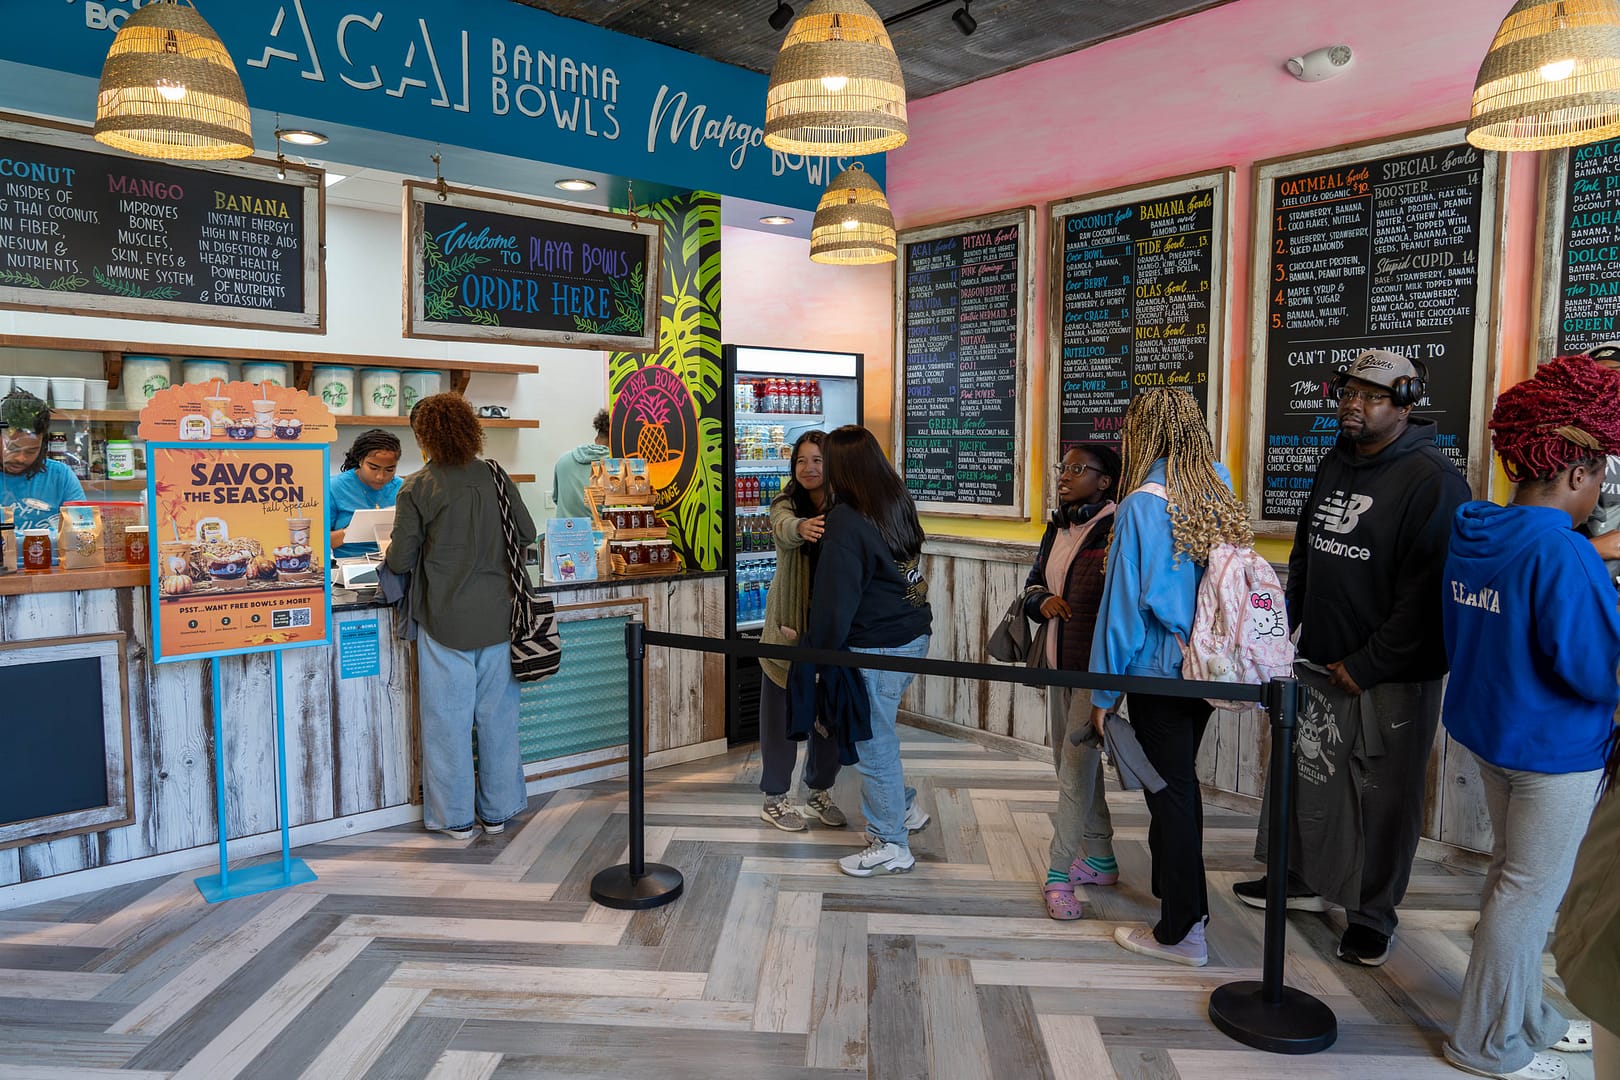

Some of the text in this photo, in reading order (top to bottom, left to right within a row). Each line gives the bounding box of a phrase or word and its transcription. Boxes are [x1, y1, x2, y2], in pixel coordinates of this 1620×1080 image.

[491, 38, 620, 103] BANANA
[491, 77, 620, 140] BOWLS
[647, 84, 766, 170] Mango
[1575, 144, 1609, 161] ACAI
[1383, 147, 1477, 180] SPECIAL bowls
[1575, 159, 1598, 169] PLAYA
[107, 174, 184, 200] MANGO
[1281, 167, 1369, 196] OATMEAL bowls
[1573, 178, 1600, 194] Pink
[6, 183, 73, 204] INSIDES OF
[1374, 180, 1428, 199] BOOSTER
[1439, 190, 1455, 199] FLAX
[214, 190, 290, 219] BANANA
[1282, 197, 1297, 207] STEEL
[1300, 195, 1311, 204] CUT
[1320, 189, 1351, 200] ORGANIC
[1574, 192, 1601, 203] PLAYA
[15, 201, 43, 217] THAI
[119, 200, 178, 220] IMPROVES
[1139, 193, 1212, 221] BANANA bowls
[1376, 197, 1473, 218] VANILLA PEANUT
[1573, 200, 1611, 212] COCONUT
[208, 212, 294, 234] INSTANT ENERGY!
[1068, 213, 1113, 233] COCONUT
[1150, 218, 1174, 229] BANANA
[1332, 213, 1360, 225] NUTELLA
[1406, 210, 1435, 222] CASHEW
[1416, 216, 1467, 230] TOPPED WITH
[0, 218, 13, 231] IN
[1152, 223, 1195, 237] ALMOND MILK
[1453, 225, 1472, 235] CHIA
[201, 226, 226, 240] HIGH
[228, 230, 239, 242] IN
[276, 235, 298, 249] AIDS
[435, 222, 519, 256] Welcome
[963, 232, 991, 250] PITAYA
[1401, 235, 1465, 251] PEANUT BUTTER
[54, 241, 68, 256] &
[199, 239, 282, 258] IN DIGESTION &
[1137, 240, 1161, 256] TIDE
[1289, 240, 1344, 256] SLICED ALMONDS
[1568, 246, 1619, 265] DOLCE
[146, 253, 175, 267] EYES
[177, 257, 187, 267] &
[199, 252, 235, 267] HEART
[500, 250, 521, 265] TO
[529, 236, 629, 278] PLAYA BOWLS
[1375, 254, 1412, 275] Stupid
[1412, 251, 1454, 269] CUPID
[106, 264, 150, 281] IMMUNE
[1289, 259, 1328, 271] CHOCOLATE
[1318, 266, 1366, 279] PEANUT BUTTER
[211, 265, 282, 285] POWERHOUSE
[199, 290, 209, 302] &
[215, 280, 286, 298] OF NUTRIENTS
[461, 273, 611, 319] ORDER HERE
[960, 285, 1007, 298] DRAGONBERRY
[1136, 284, 1162, 298] OLAS
[1287, 283, 1345, 297] MAPLE SYRUP &
[1565, 284, 1586, 296] The
[1288, 294, 1340, 307] BROWN SUGAR
[1418, 298, 1456, 308] COCONUT
[1401, 307, 1470, 319] WHITE CHOCOLATE
[1565, 311, 1598, 320] ALMOND
[1329, 317, 1340, 326] FIG
[1371, 317, 1453, 331] & NUTELLA DRIZZLES
[1563, 317, 1614, 332] GREEN
[960, 335, 987, 345] NUTAYA
[1135, 327, 1160, 340] NICA
[1288, 349, 1326, 366] CAN'T
[1427, 343, 1445, 357] TO
[959, 362, 976, 371] GOJI
[1082, 380, 1106, 391] POWER
[1134, 373, 1164, 386] COSTA
[621, 370, 689, 409] PLAYA BOWLS
[1290, 399, 1323, 409] COMBINE
[928, 418, 959, 429] GREEN
[1089, 432, 1111, 440] HIGHEST
[959, 441, 987, 451] PACIFIC
[1269, 447, 1319, 455] CHICORY COFFEE
[1286, 456, 1314, 464] ORLEANS
[191, 462, 295, 486] SAVOR
[184, 486, 304, 504] THE SEASON
[656, 482, 680, 506] RANGE
[262, 497, 319, 515] Fall Specials
[1314, 534, 1371, 561] balance
[230, 602, 249, 610] FREE
[250, 599, 277, 608] BOWLS
[286, 597, 311, 606] MORE?
